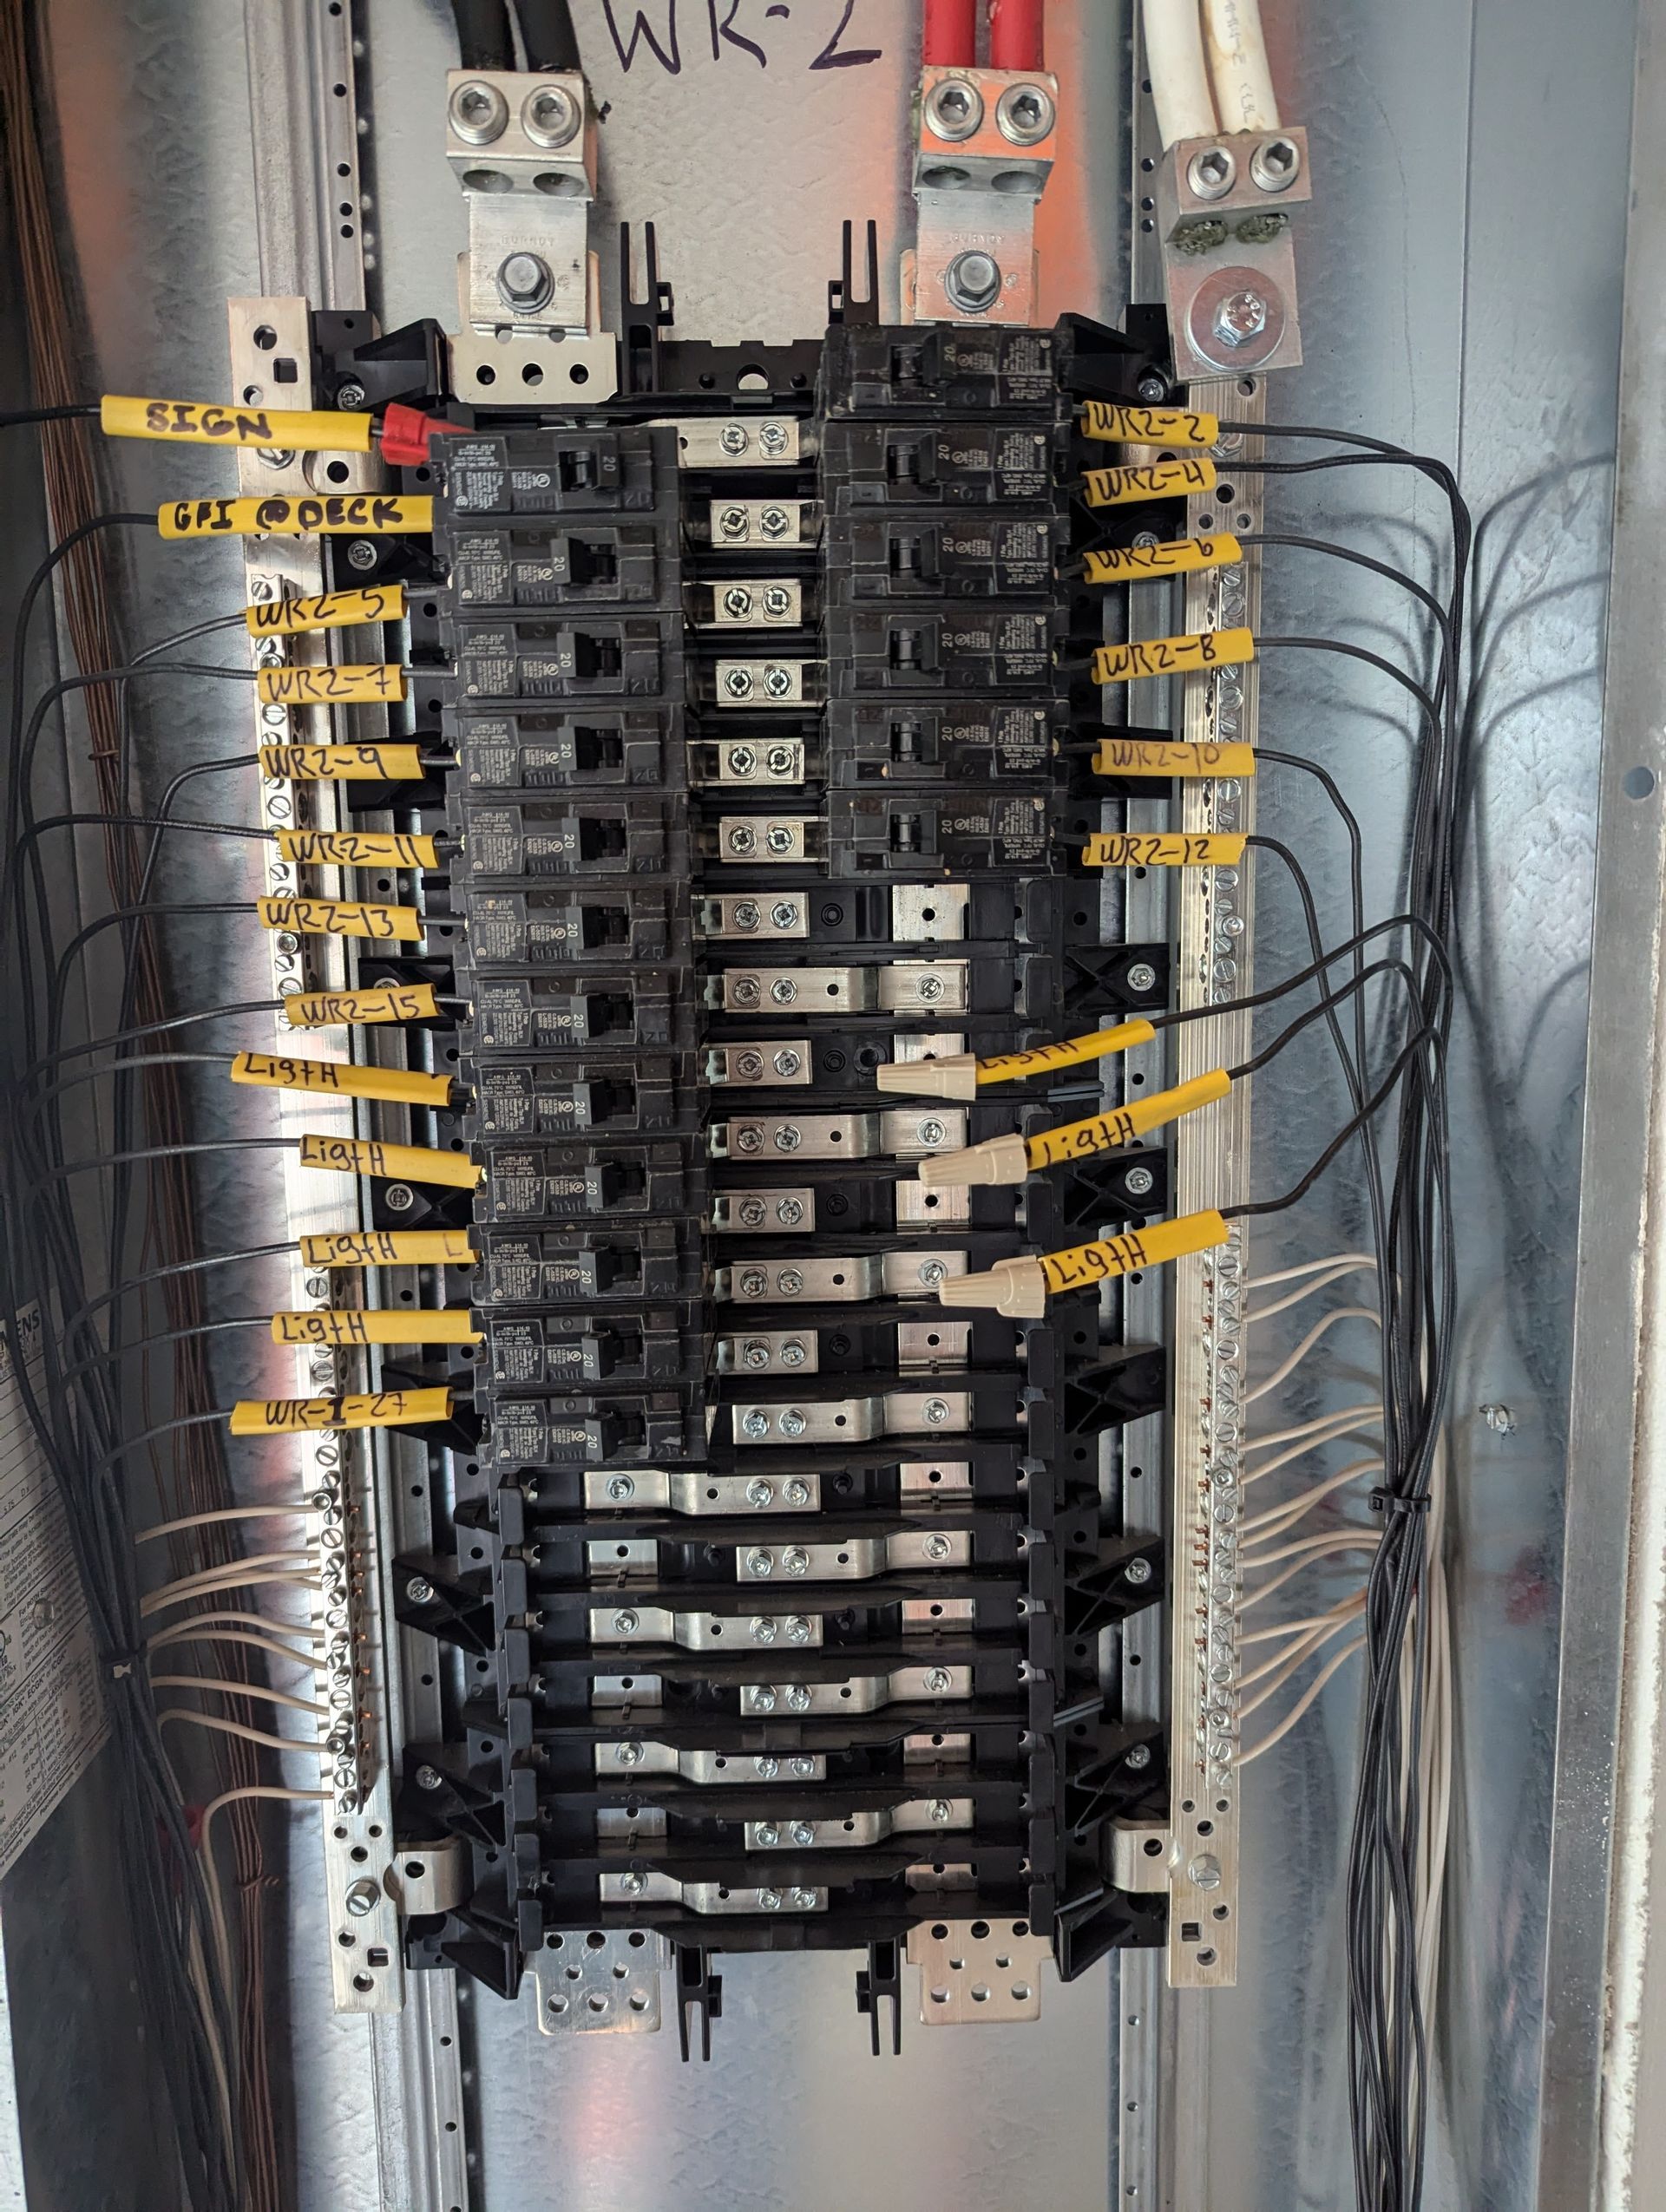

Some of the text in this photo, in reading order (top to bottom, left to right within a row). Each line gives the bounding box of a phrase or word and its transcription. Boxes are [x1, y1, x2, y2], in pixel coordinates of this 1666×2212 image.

[944, 346, 955, 362] 20
[145, 402, 272, 441] SIGN
[1093, 403, 1205, 442] WR2-2
[938, 444, 949, 460] 20
[603, 456, 616, 472] 20
[1095, 461, 1205, 501] WR2-4
[942, 537, 954, 552] 20
[1094, 538, 1214, 569] WR2-6
[554, 556, 566, 572] 20
[256, 589, 384, 628] WR2-5
[942, 632, 954, 648] 20
[560, 652, 572, 667] 20
[1104, 634, 1217, 677] WR2-8
[267, 666, 391, 701] WR2-7
[941, 727, 953, 742] 20
[561, 743, 572, 758] 20
[1112, 742, 1220, 774] WR2-10
[266, 746, 390, 779] WR2-9
[941, 819, 952, 834] 20
[564, 834, 575, 848] 20
[1100, 835, 1210, 866] WR2-12
[266, 900, 394, 938] WR2-13
[567, 923, 579, 938] 20
[301, 993, 420, 1024] WR2-15
[573, 1014, 584, 1029] 20
[574, 1100, 586, 1115] 20
[587, 1181, 598, 1195] 20
[581, 1270, 592, 1284] 20
[582, 1353, 594, 1368] 20
[266, 1392, 407, 1428] WR-1-27
[587, 1435, 598, 1450] 20
